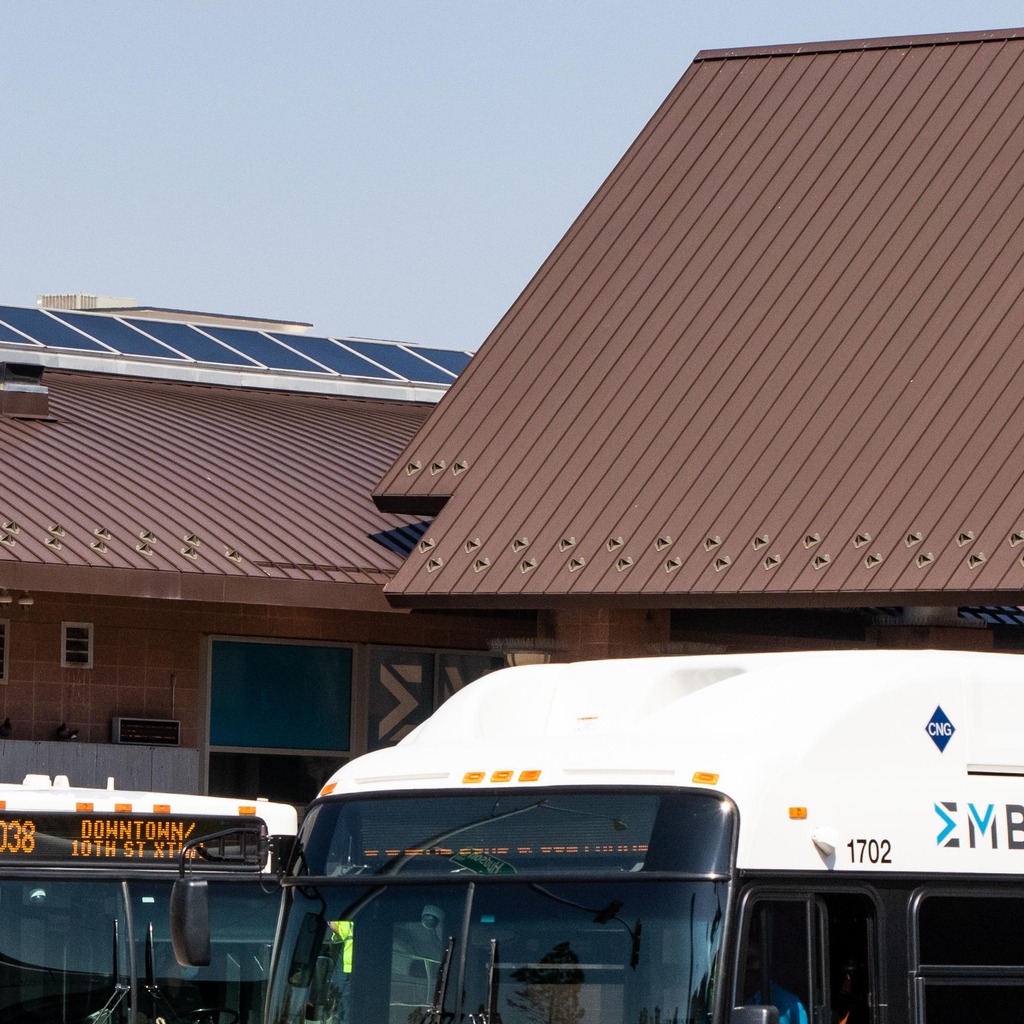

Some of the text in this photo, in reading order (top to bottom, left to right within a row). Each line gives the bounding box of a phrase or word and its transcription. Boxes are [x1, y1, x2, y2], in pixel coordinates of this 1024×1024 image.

[928, 722, 952, 737] CNG
[81, 819, 197, 841] DOWNTOWN/
[72, 839, 118, 857] 10TH
[123, 840, 145, 858] ST
[847, 839, 892, 864] 1702
